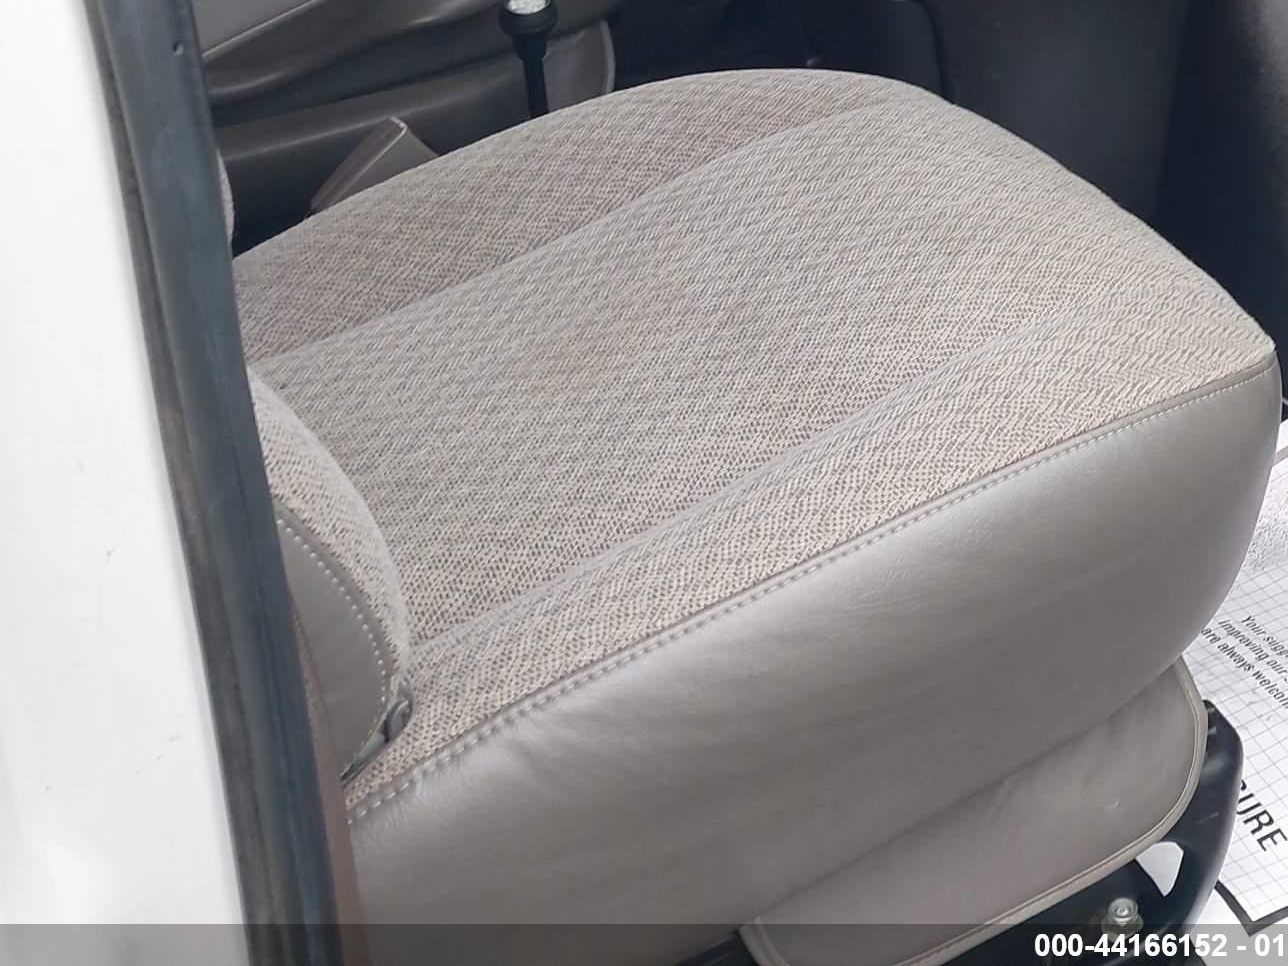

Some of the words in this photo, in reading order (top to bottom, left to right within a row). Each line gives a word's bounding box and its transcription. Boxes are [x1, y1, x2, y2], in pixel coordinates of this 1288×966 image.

[1218, 619, 1270, 661] improving
[1266, 659, 1288, 675] our
[1241, 615, 1266, 636] Your
[1201, 628, 1222, 644] are
[1217, 642, 1255, 672] always
